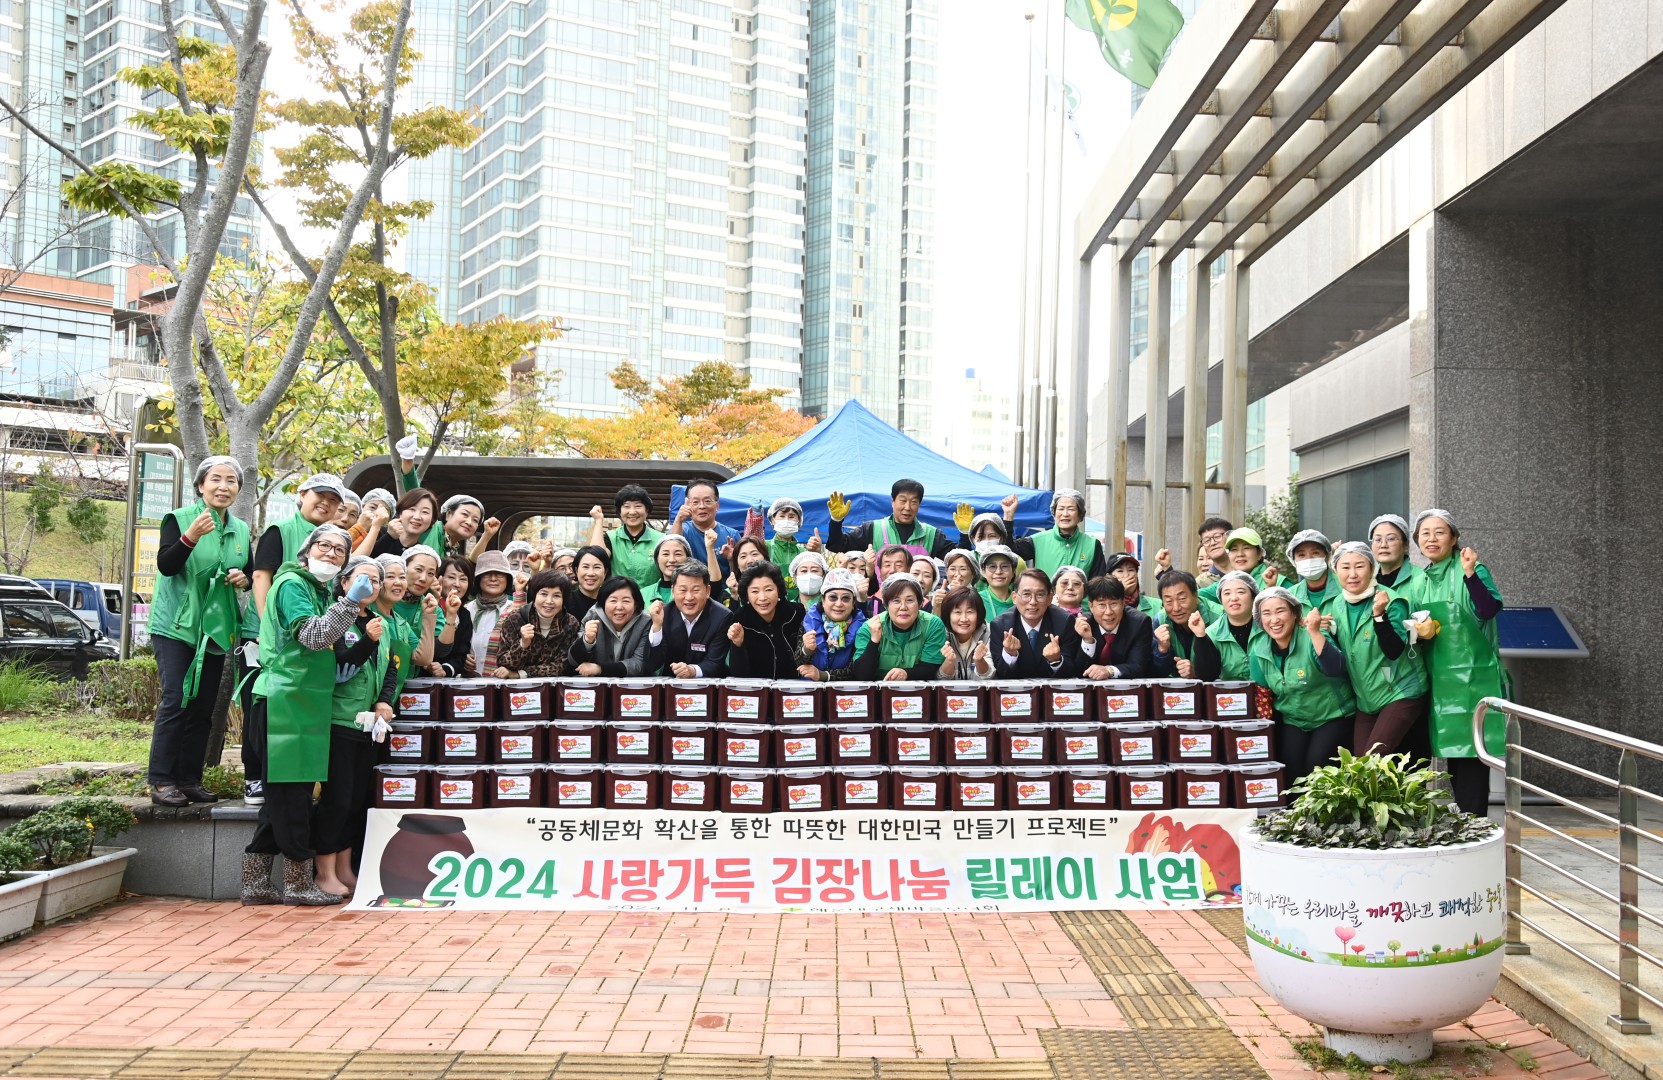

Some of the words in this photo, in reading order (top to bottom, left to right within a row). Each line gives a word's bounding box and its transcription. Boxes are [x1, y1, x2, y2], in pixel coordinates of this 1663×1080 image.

[654, 818, 719, 841] 확산을
[730, 817, 772, 840] 통한
[783, 818, 847, 841] 따뜻한
[858, 818, 942, 841] 대한민국
[953, 817, 1015, 840] 만들기
[429, 855, 559, 899] 2024
[572, 858, 755, 902] 사랑가득
[772, 857, 950, 904] 김장나눔
[966, 856, 1098, 900] 릴레이
[1115, 857, 1200, 900] 사업
[1264, 893, 1300, 916] 가꾸는
[1366, 901, 1434, 923] 깨끗하고
[1438, 892, 1483, 917] 쾌적한
